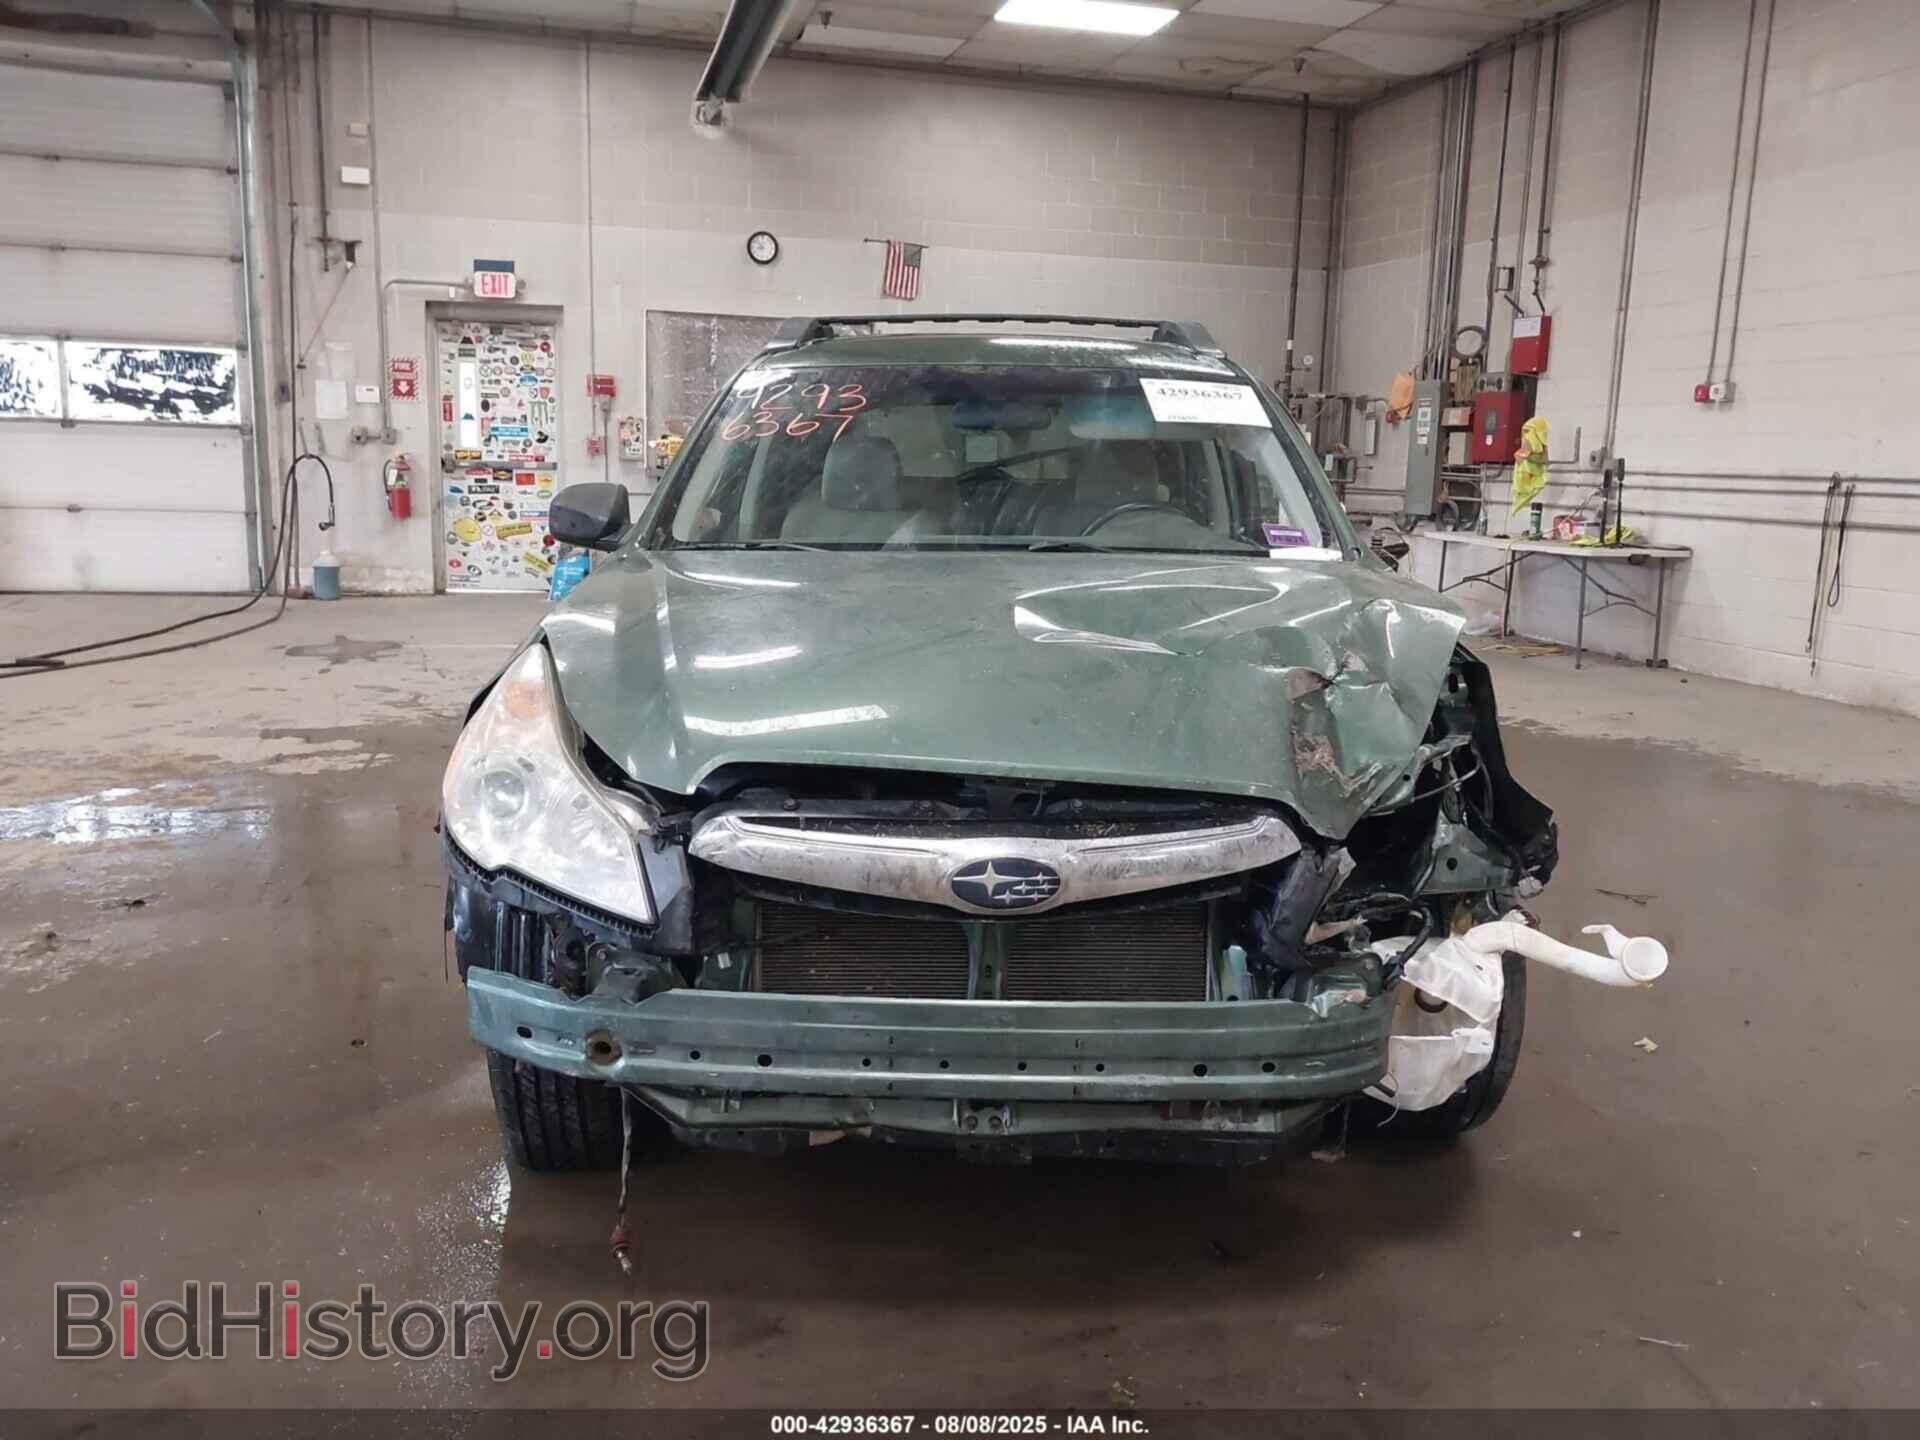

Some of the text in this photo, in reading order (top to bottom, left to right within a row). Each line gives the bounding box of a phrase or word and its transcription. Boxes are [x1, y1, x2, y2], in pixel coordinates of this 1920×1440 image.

[481, 273, 509, 297] EXIT
[1158, 387, 1243, 401] 42936367
[722, 410, 853, 442] 6367
